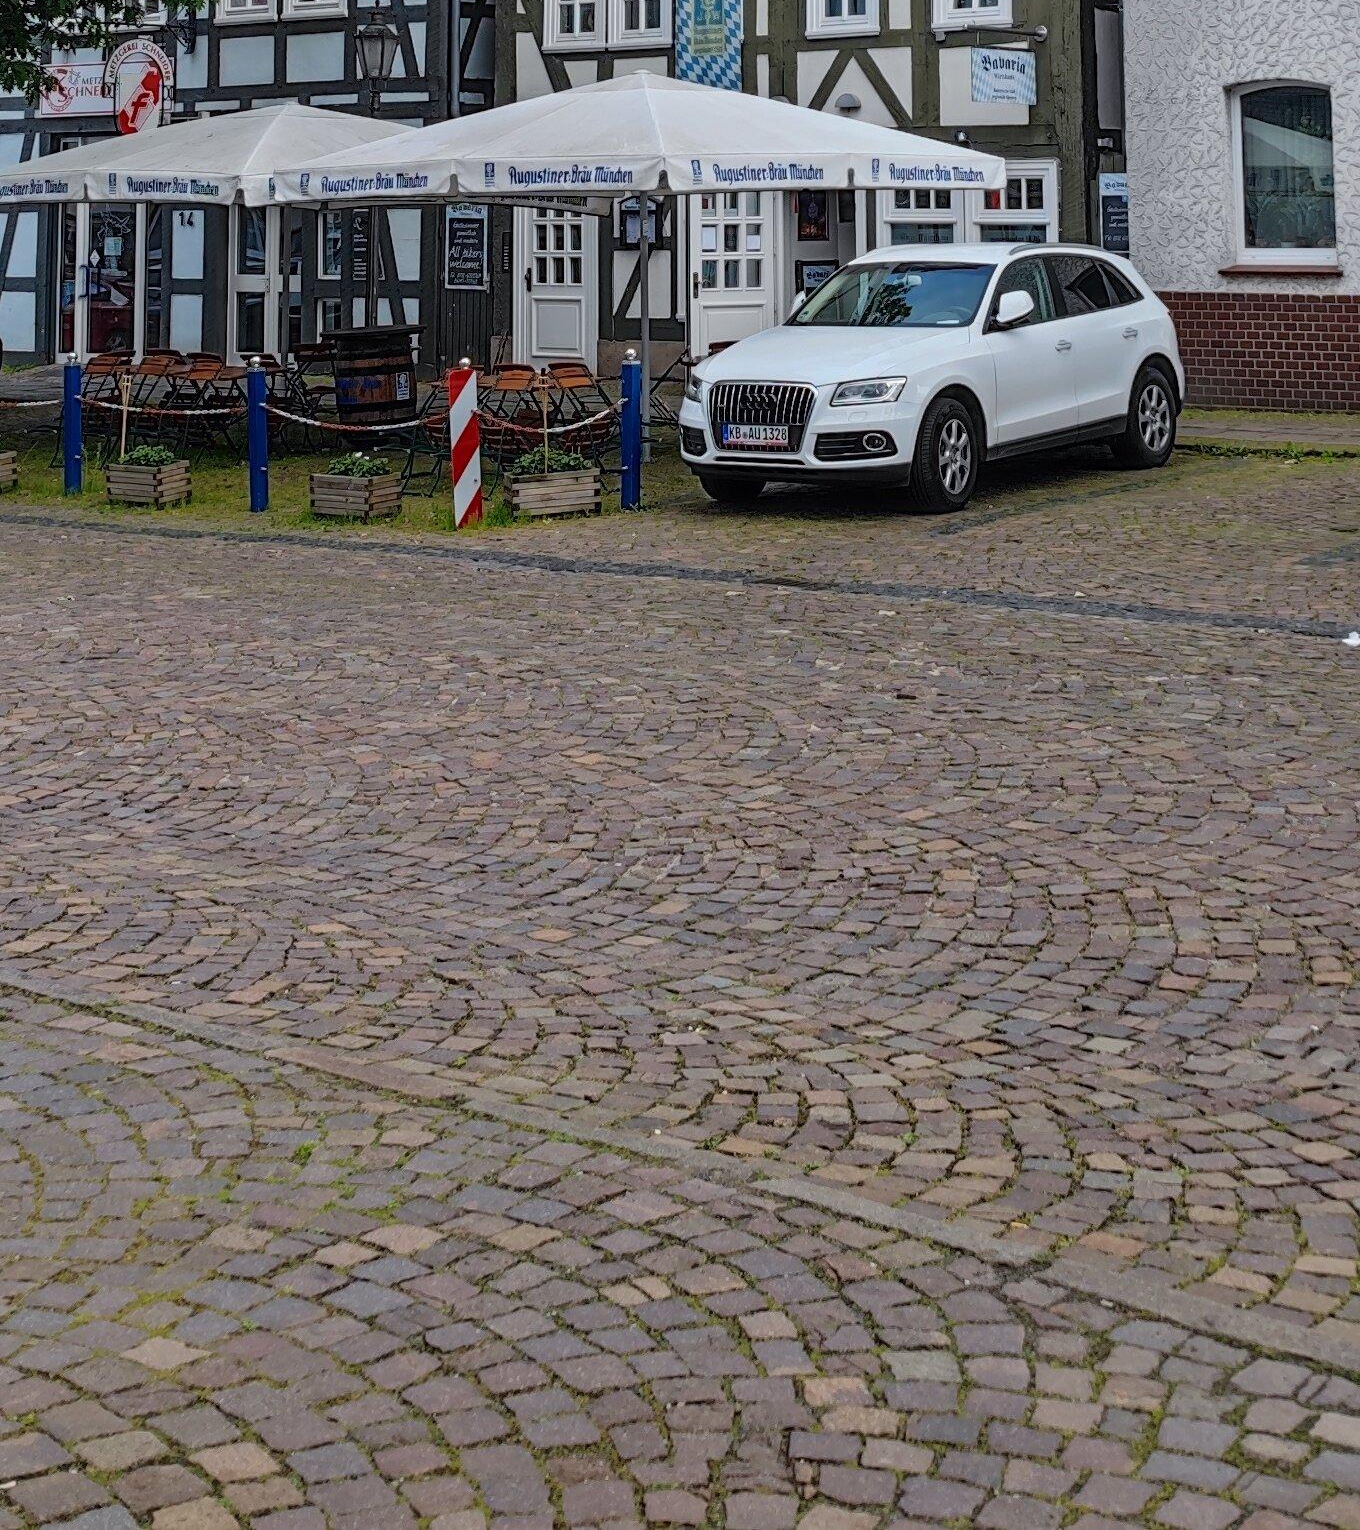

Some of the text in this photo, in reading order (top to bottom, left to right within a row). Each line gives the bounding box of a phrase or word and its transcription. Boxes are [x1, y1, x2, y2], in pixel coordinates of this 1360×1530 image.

[109, 43, 171, 82] METZGEREI SCHNEIDER
[981, 54, 1026, 75] Bavaria
[594, 166, 634, 184] München
[789, 163, 824, 180] München
[953, 166, 985, 182] München
[396, 172, 429, 189] München
[729, 427, 787, 440] KB AU 1328
